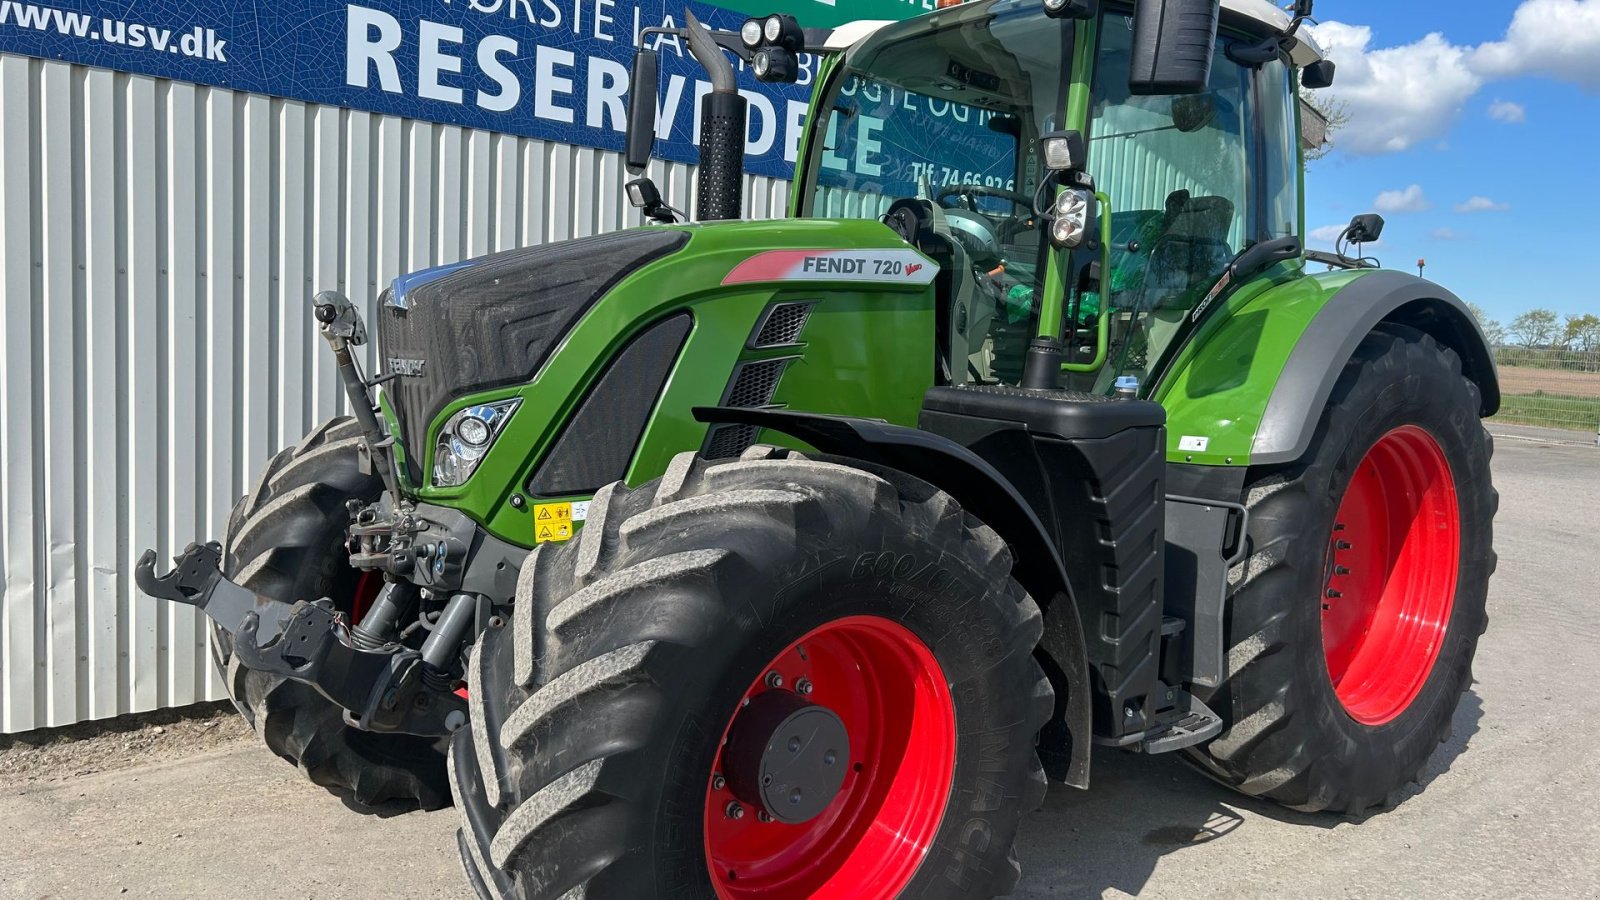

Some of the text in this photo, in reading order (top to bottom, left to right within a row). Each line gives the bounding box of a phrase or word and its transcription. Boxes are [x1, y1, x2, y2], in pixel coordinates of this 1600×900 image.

[912, 162, 937, 186] Tlf.
[941, 167, 960, 187] 74
[963, 172, 981, 186] 66
[803, 256, 866, 275] FENDT
[873, 259, 902, 275] 720
